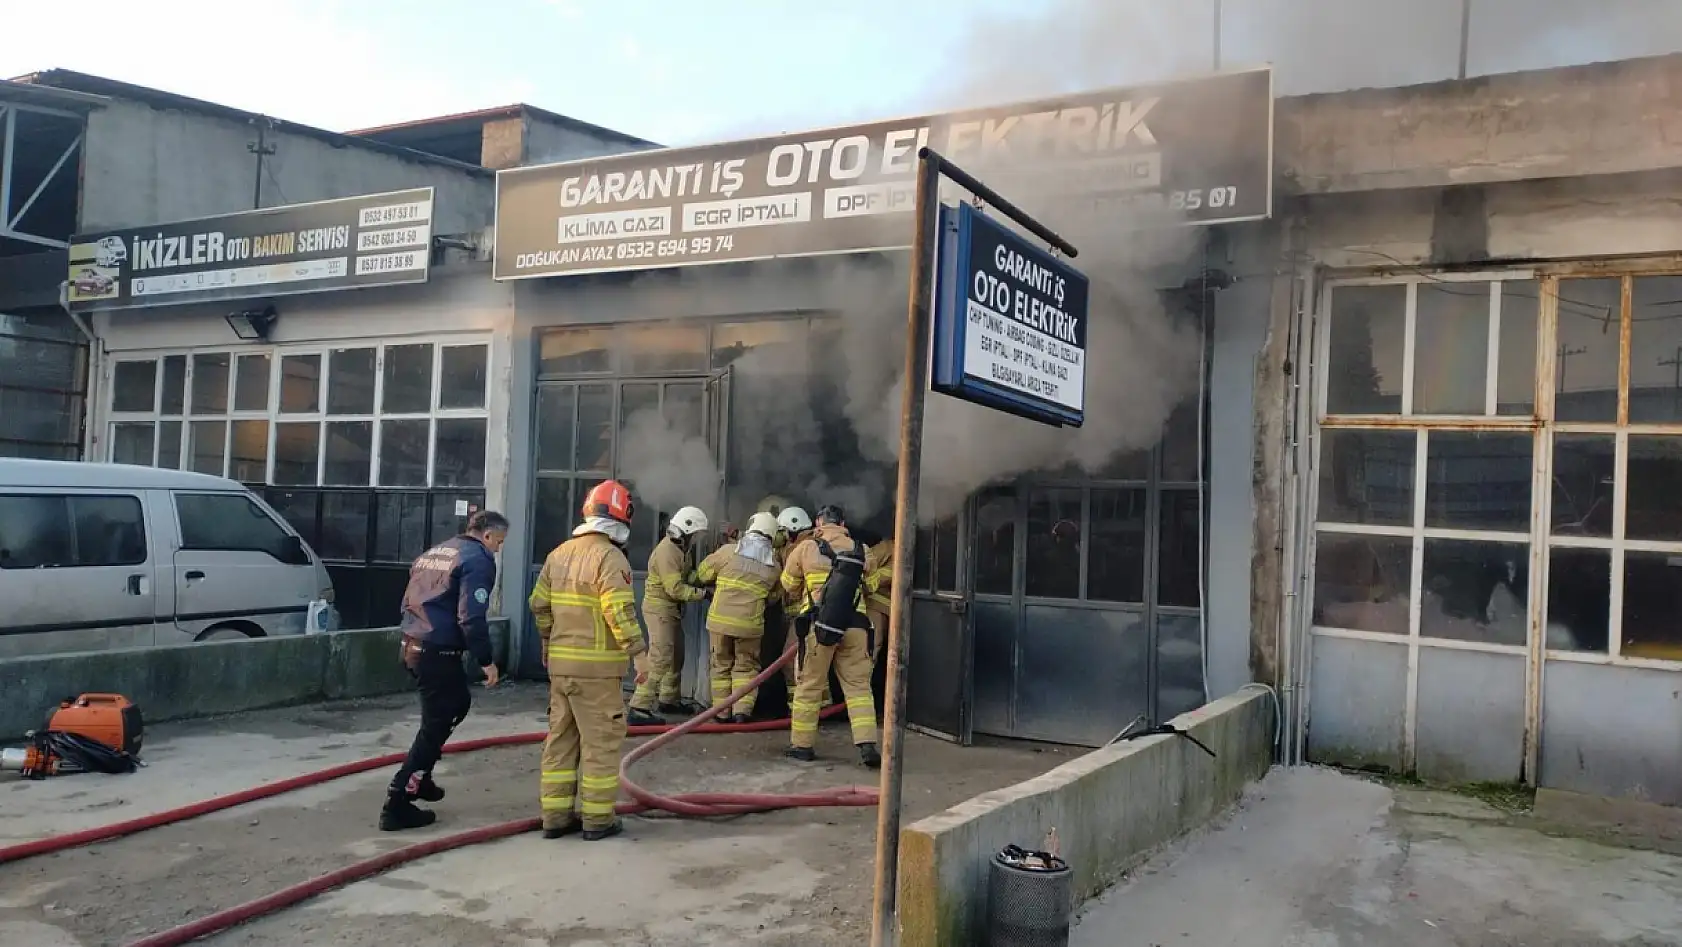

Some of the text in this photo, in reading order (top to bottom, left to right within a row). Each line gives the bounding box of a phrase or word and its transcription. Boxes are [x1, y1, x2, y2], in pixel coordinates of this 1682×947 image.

[710, 159, 746, 198] İŞ
[766, 135, 870, 187] OTO
[564, 217, 618, 239] KLİMA
[622, 216, 664, 233] GAZI
[694, 208, 732, 226] EGR
[737, 197, 798, 222] İPTALİ
[836, 193, 878, 212] DPF
[1208, 185, 1237, 208] 01
[132, 224, 350, 271] İKİZLER OTO BAKIM SERVİSİ
[516, 235, 734, 269] DOĞUKAN AYAZ 0532 694 99 74
[995, 244, 1066, 309] GARANTİ İŞ
[974, 270, 1078, 344] OTO ELEKTRİK
